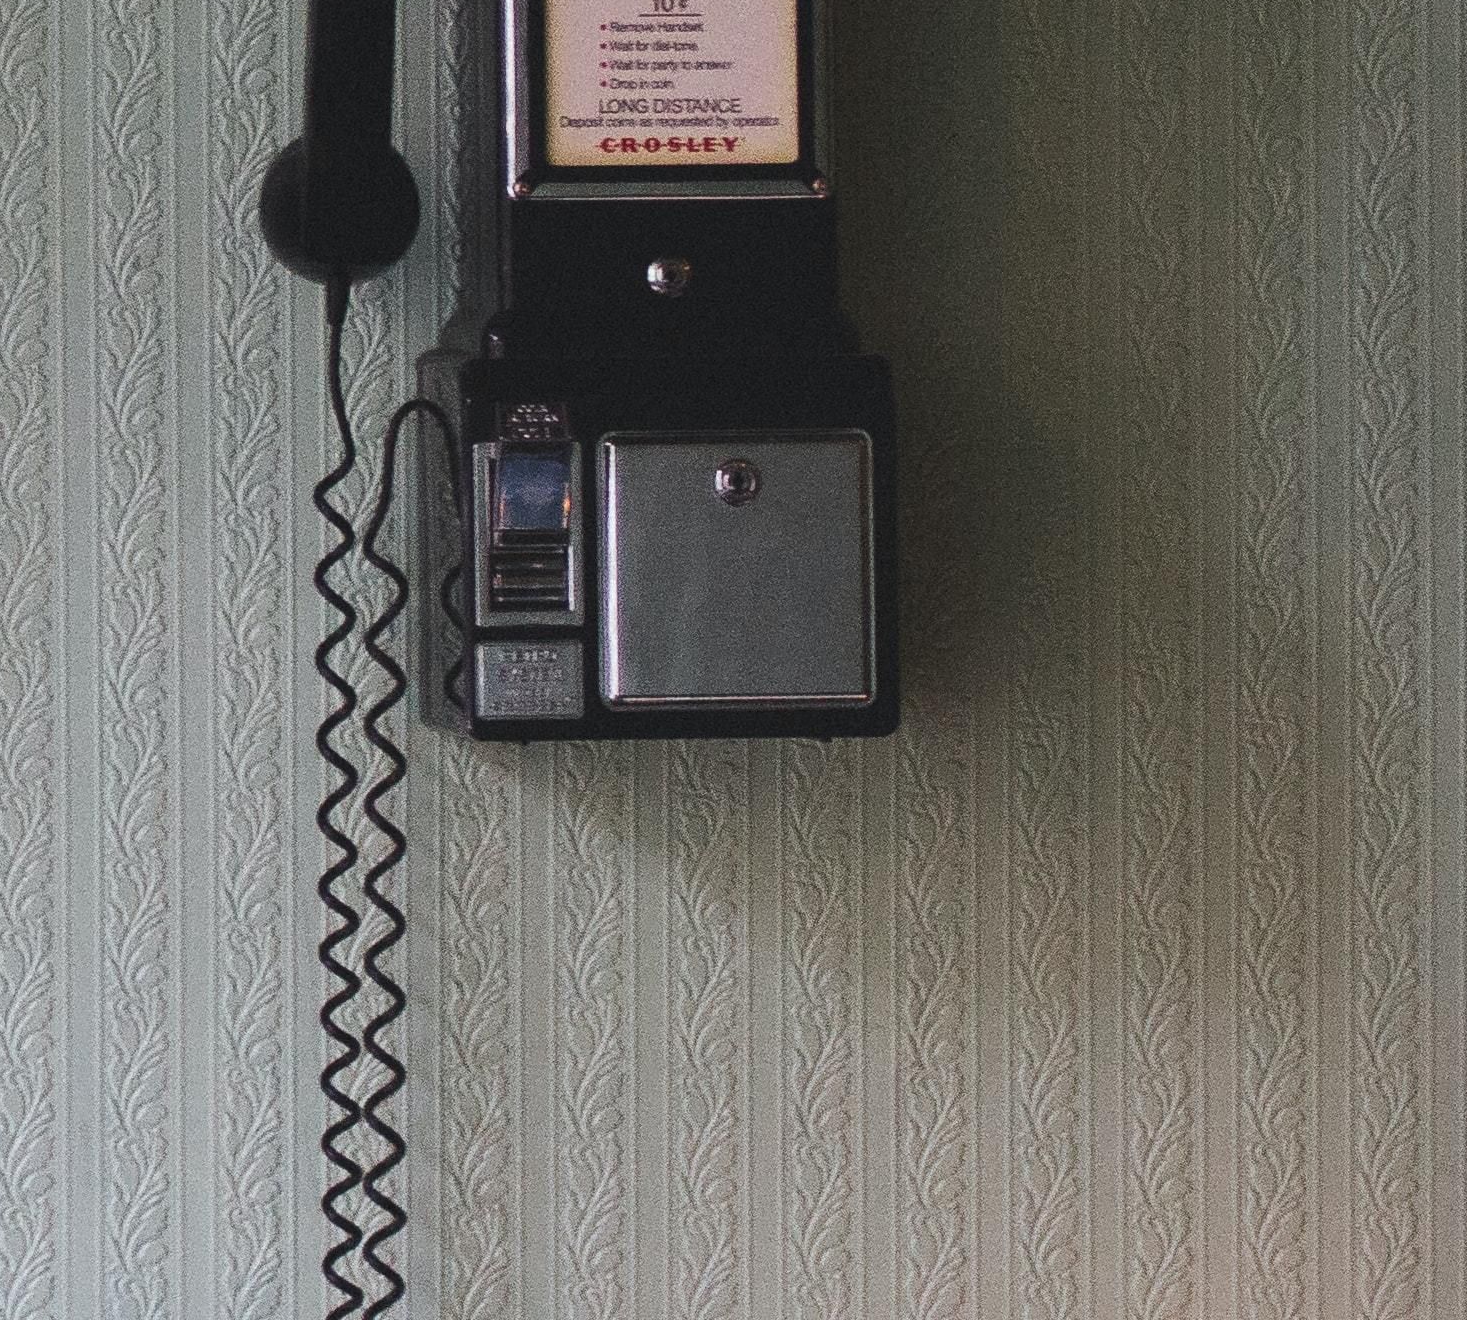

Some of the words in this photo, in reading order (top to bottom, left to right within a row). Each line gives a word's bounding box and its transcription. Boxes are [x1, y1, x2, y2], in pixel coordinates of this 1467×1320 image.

[609, 22, 656, 33] Remove
[609, 40, 634, 52] Wait
[635, 40, 649, 52] for
[609, 59, 634, 70] Wait
[635, 59, 649, 70] for
[651, 60, 679, 72] party
[680, 60, 692, 70] to
[609, 78, 638, 90] Drop
[638, 79, 650, 89] in
[598, 98, 649, 114] LONG
[653, 97, 742, 114] DISTANCE
[560, 116, 604, 129] Deposit
[606, 117, 636, 127] coins
[639, 117, 653, 127] as
[655, 116, 713, 129] requested
[715, 116, 731, 129] by
[599, 137, 739, 153] CROSLEY
